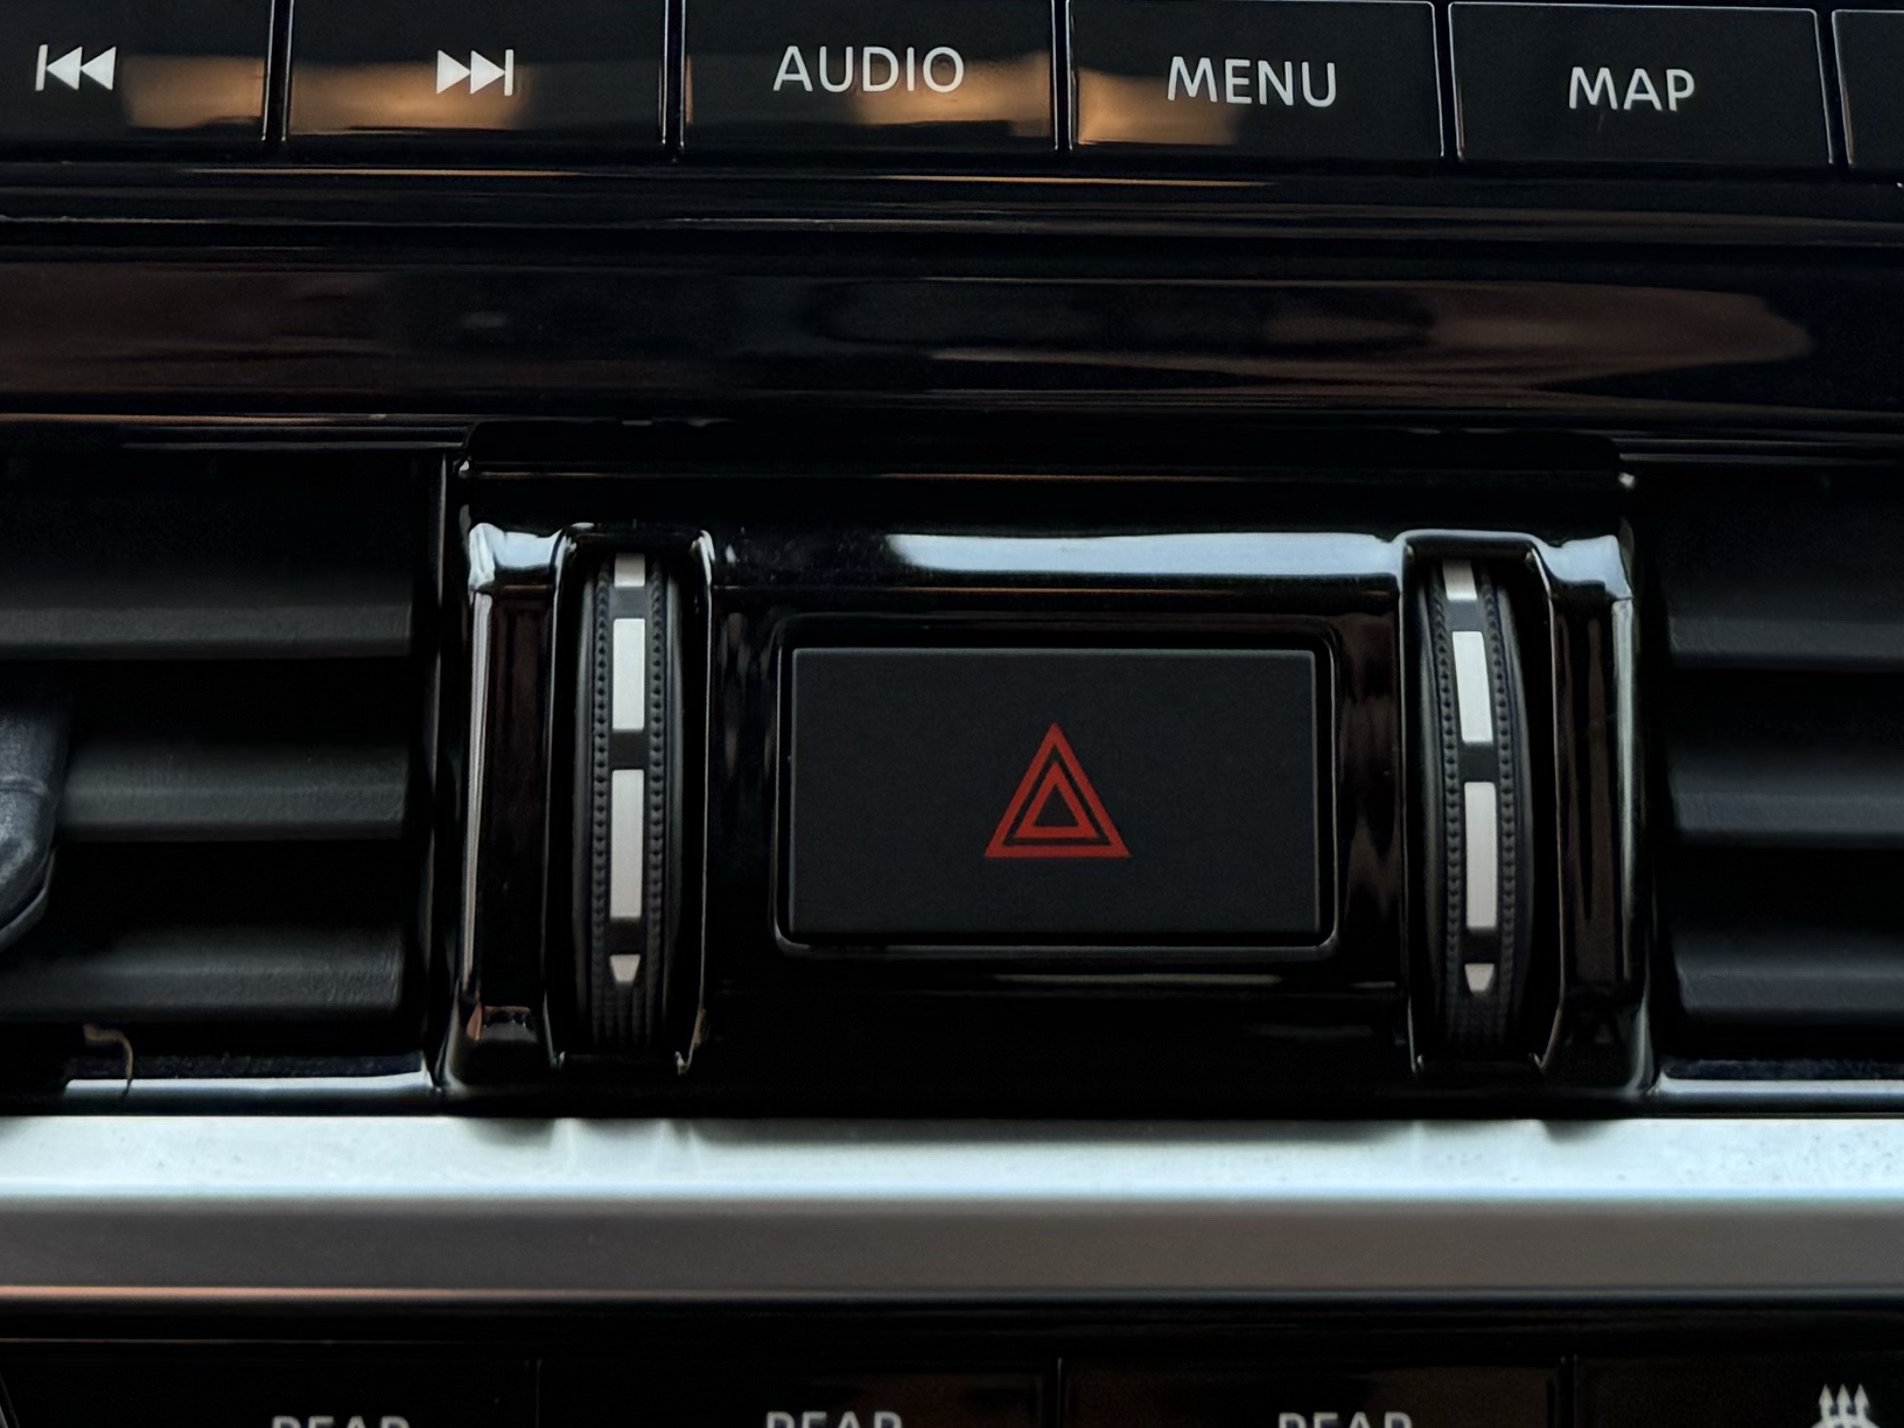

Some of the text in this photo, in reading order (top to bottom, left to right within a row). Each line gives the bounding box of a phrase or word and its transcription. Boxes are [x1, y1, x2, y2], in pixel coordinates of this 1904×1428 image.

[773, 46, 966, 95] AUDIO
[1168, 57, 1335, 107] MENU
[1570, 67, 1694, 111] MAP
